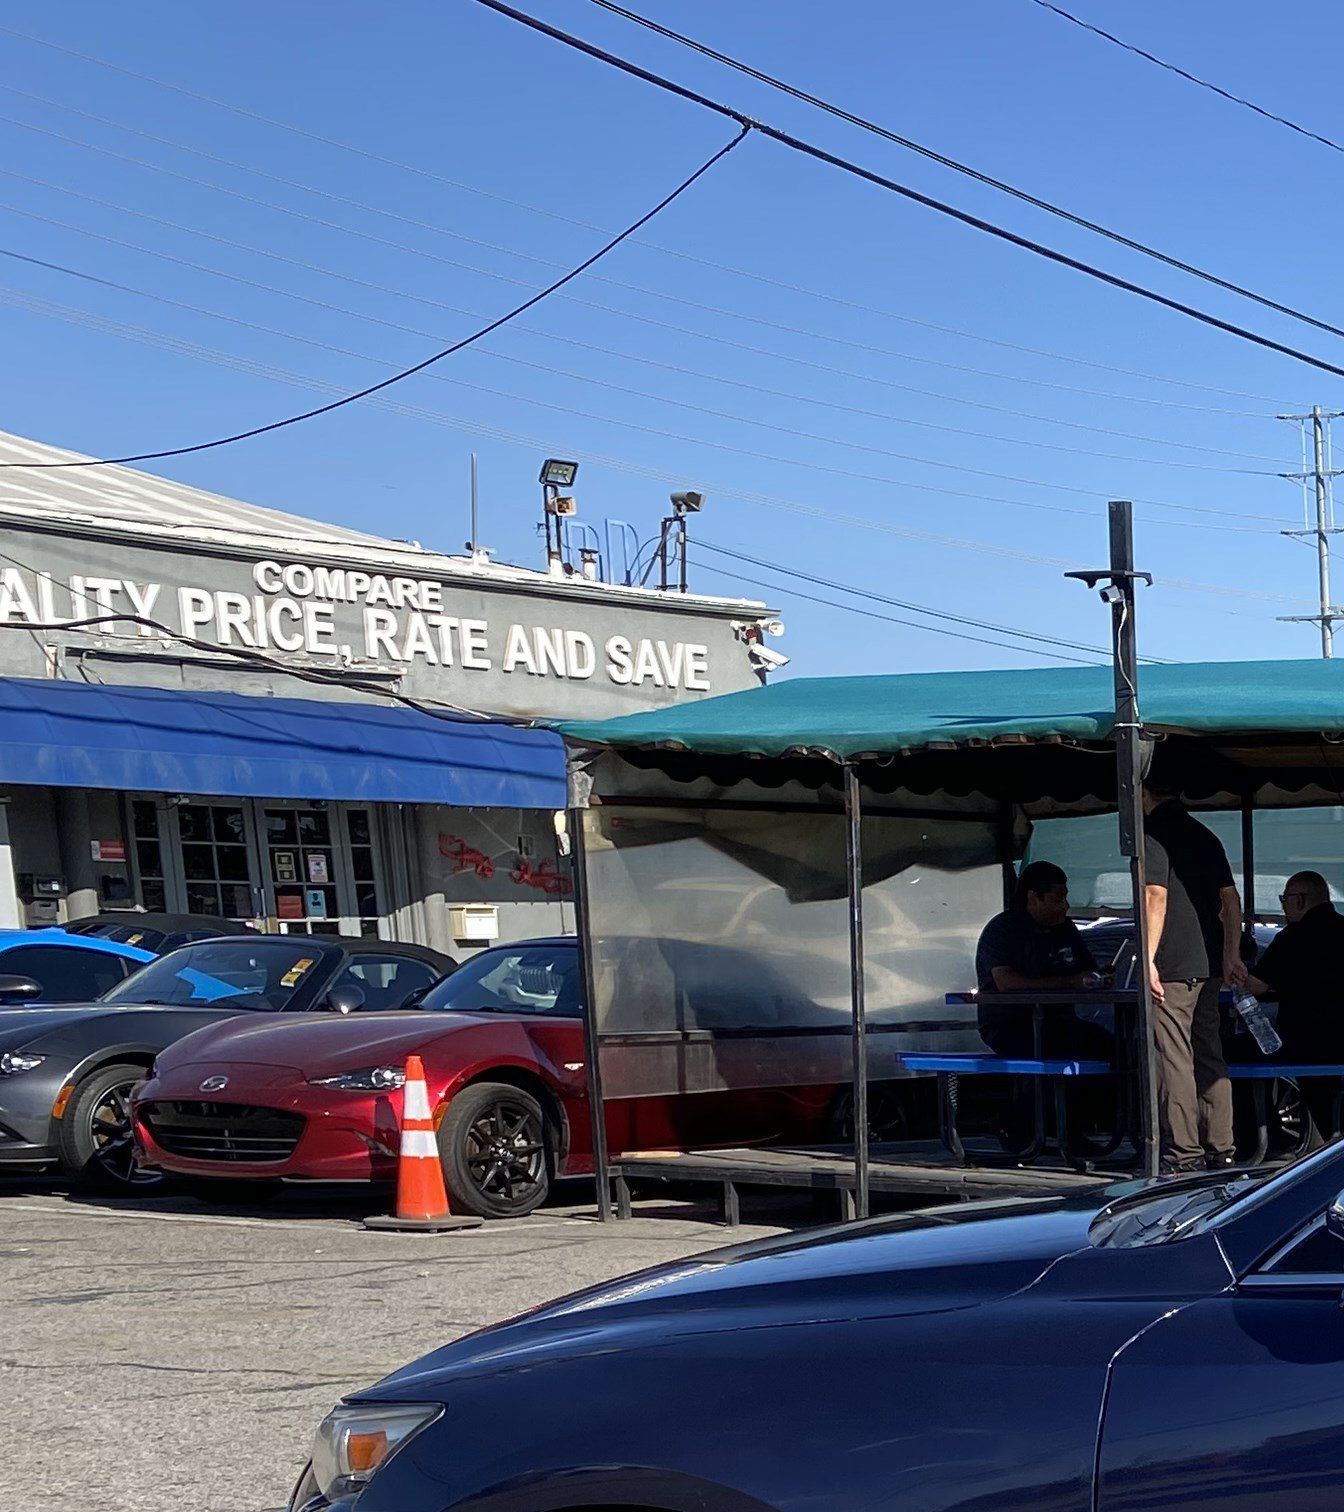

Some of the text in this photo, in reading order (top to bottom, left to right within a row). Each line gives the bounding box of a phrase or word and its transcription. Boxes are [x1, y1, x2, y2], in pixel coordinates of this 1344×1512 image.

[253, 561, 444, 613] COMPARE
[177, 586, 352, 666] PRICE,
[363, 607, 492, 671] RATE
[502, 623, 597, 679] AND
[605, 635, 711, 690] SAVE
